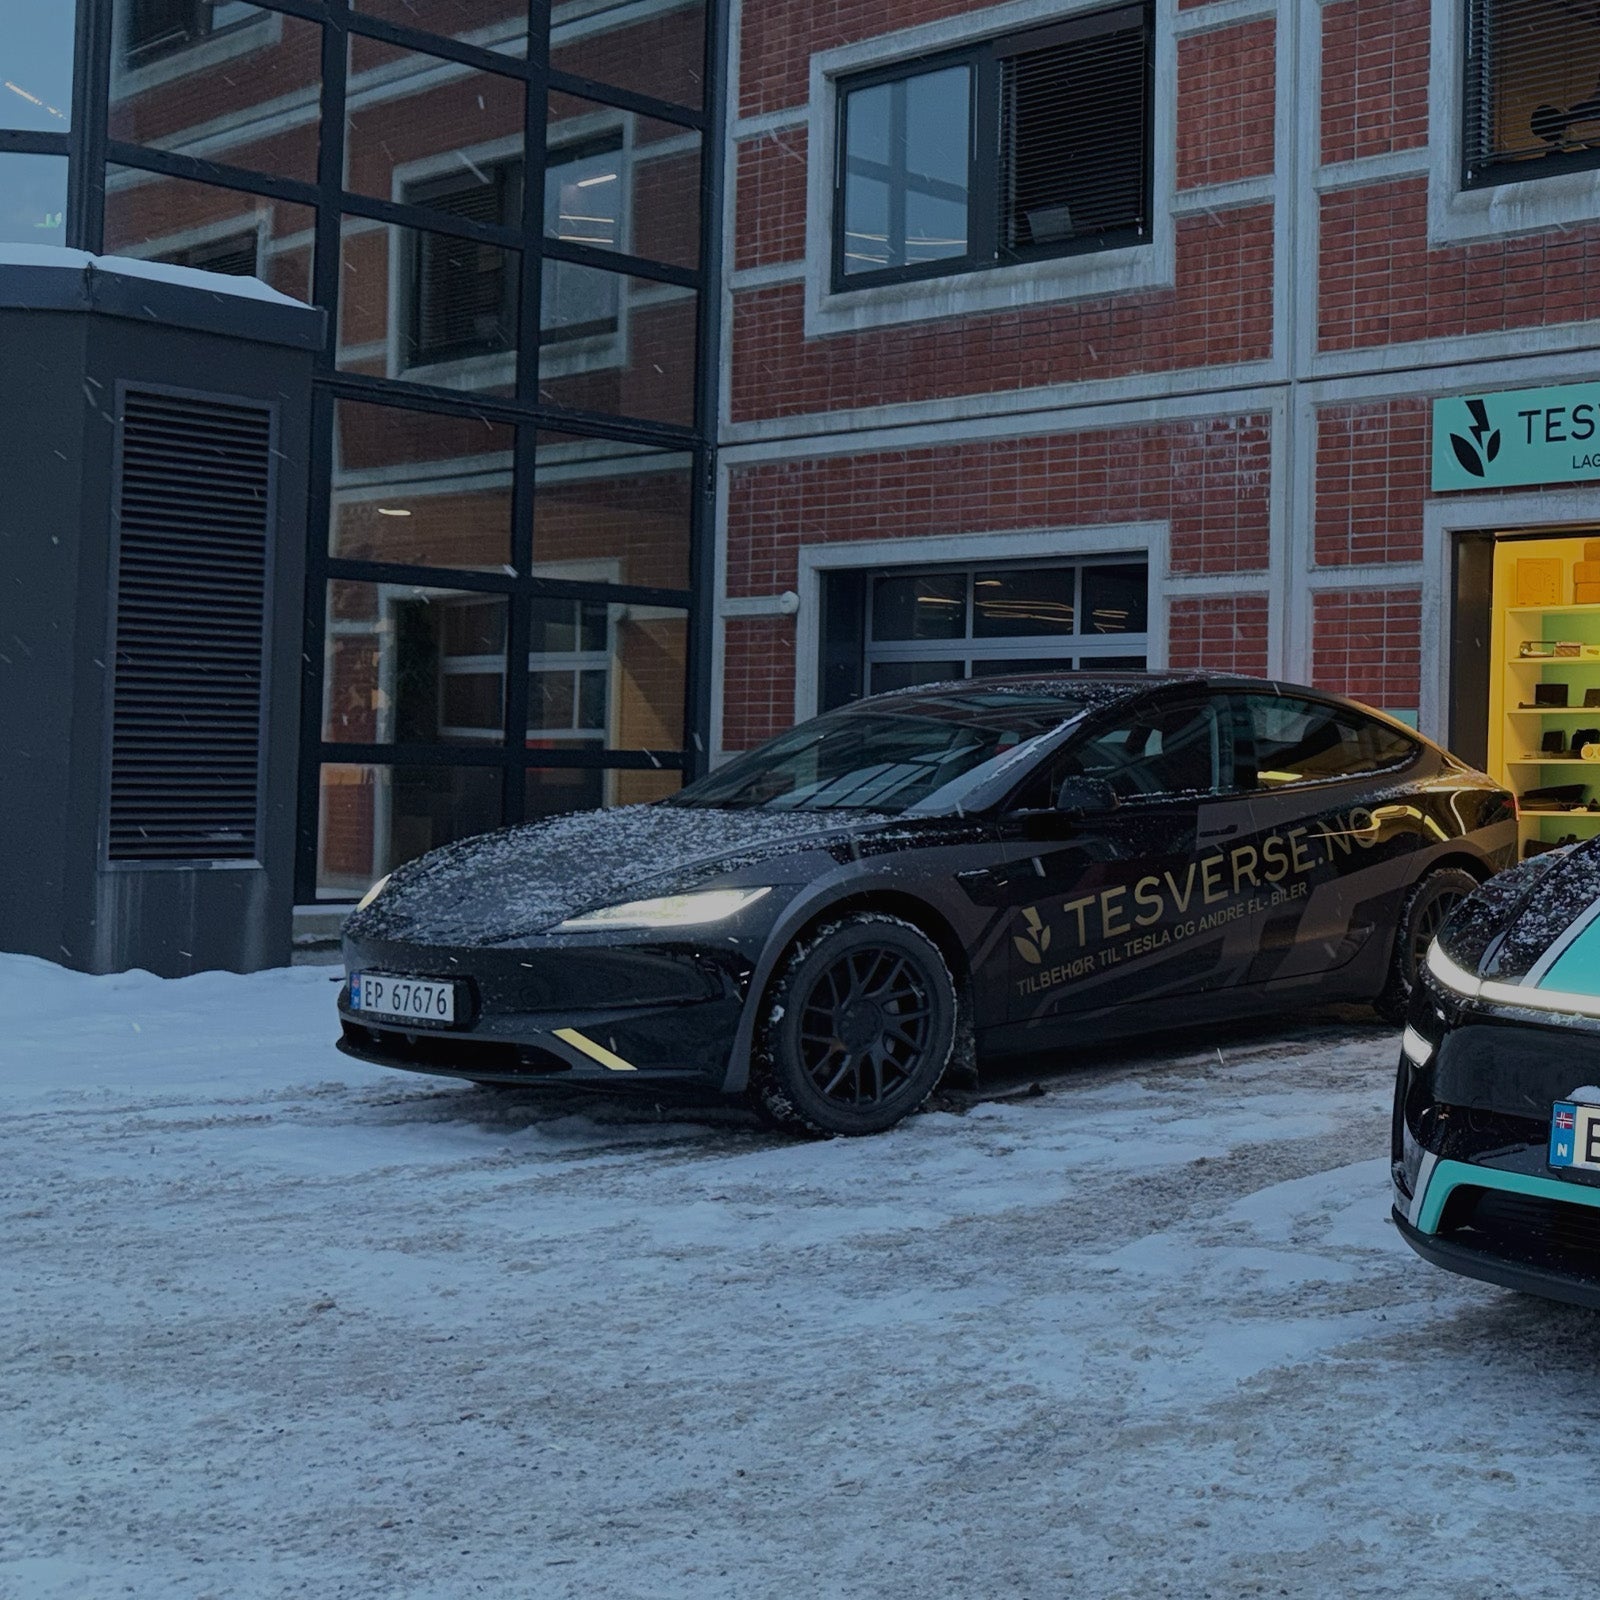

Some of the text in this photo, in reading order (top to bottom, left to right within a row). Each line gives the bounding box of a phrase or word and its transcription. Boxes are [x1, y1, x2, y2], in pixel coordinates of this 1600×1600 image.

[1063, 806, 1380, 947] TESVERSE.NO
[1016, 954, 1097, 997] TILBEHØR
[1098, 945, 1122, 966] TIL
[1124, 929, 1172, 959] TESLA
[1173, 922, 1196, 946] OG
[1198, 902, 1245, 933] ANDRE
[365, 980, 447, 1016] EP 67676
[1556, 1143, 1568, 1159] N
